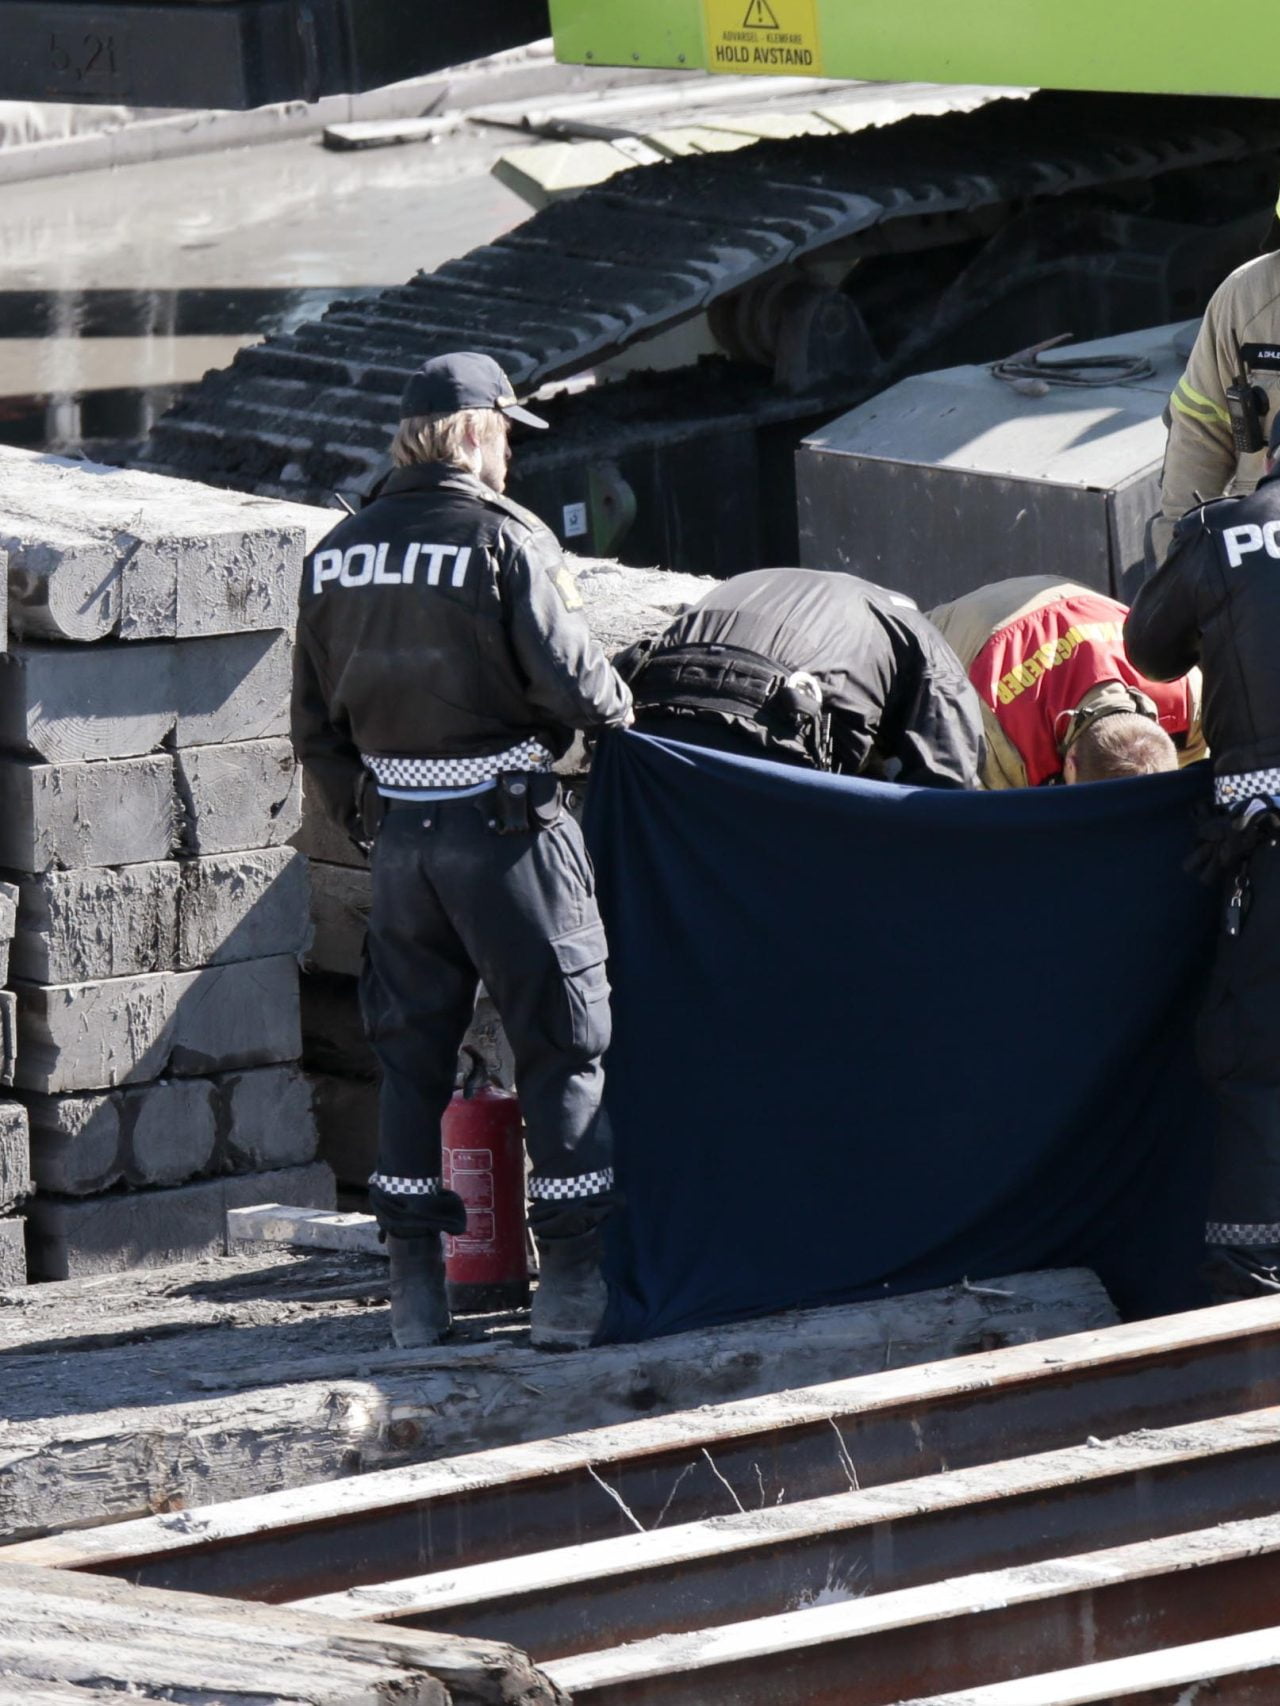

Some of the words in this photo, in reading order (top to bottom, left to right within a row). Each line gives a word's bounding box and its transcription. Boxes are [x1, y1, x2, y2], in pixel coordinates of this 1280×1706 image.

[715, 45, 749, 62] HOLD
[753, 47, 813, 66] AVSTAND
[313, 542, 472, 595] POLITI
